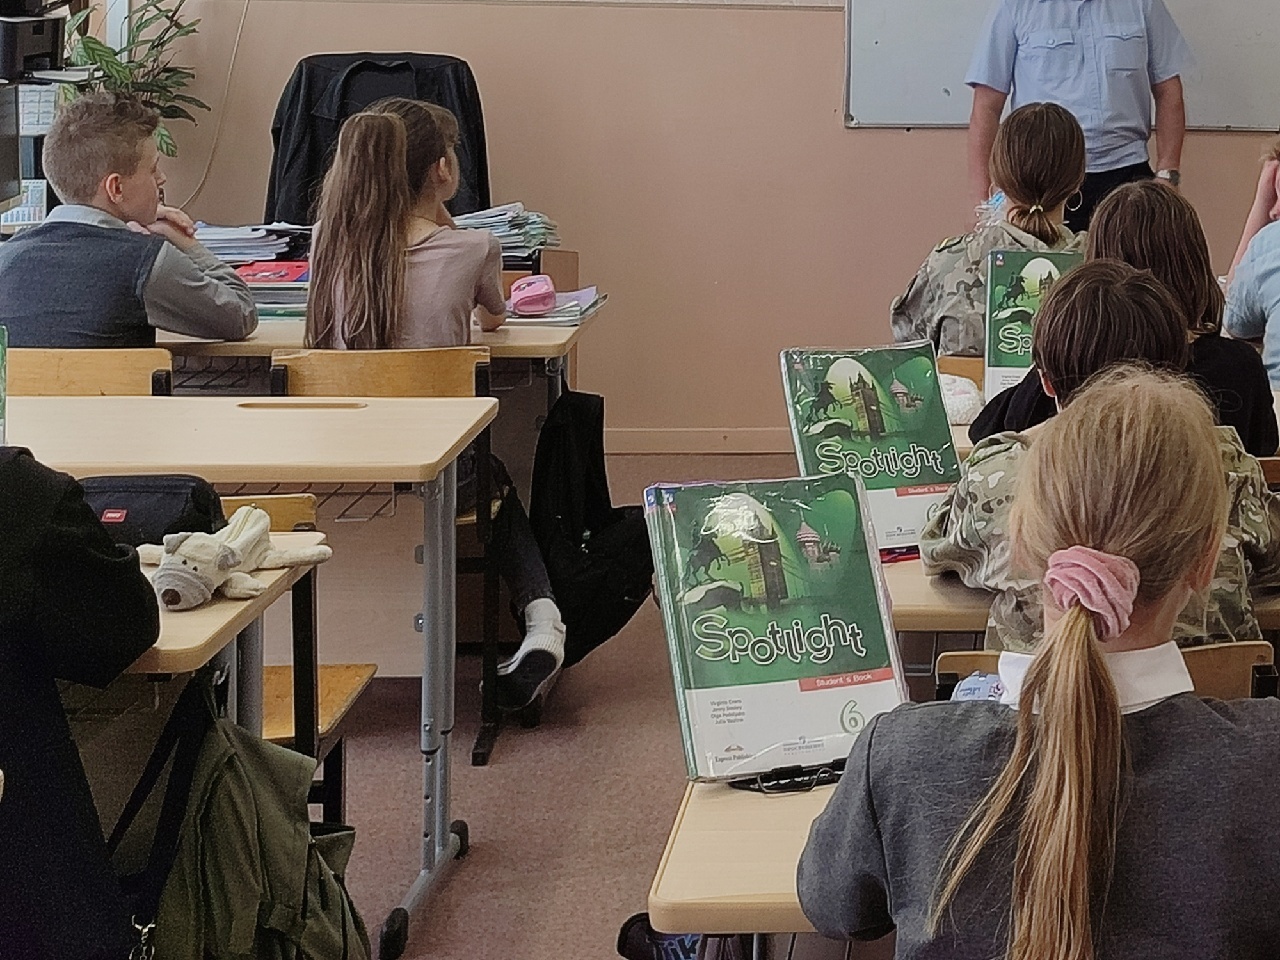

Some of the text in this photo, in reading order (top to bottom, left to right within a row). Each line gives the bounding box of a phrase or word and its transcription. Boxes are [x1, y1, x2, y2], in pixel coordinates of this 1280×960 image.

[816, 441, 944, 478] Spotlight
[692, 613, 866, 665] Spotlight
[816, 673, 872, 687] Student's Book
[840, 700, 866, 734] 6
